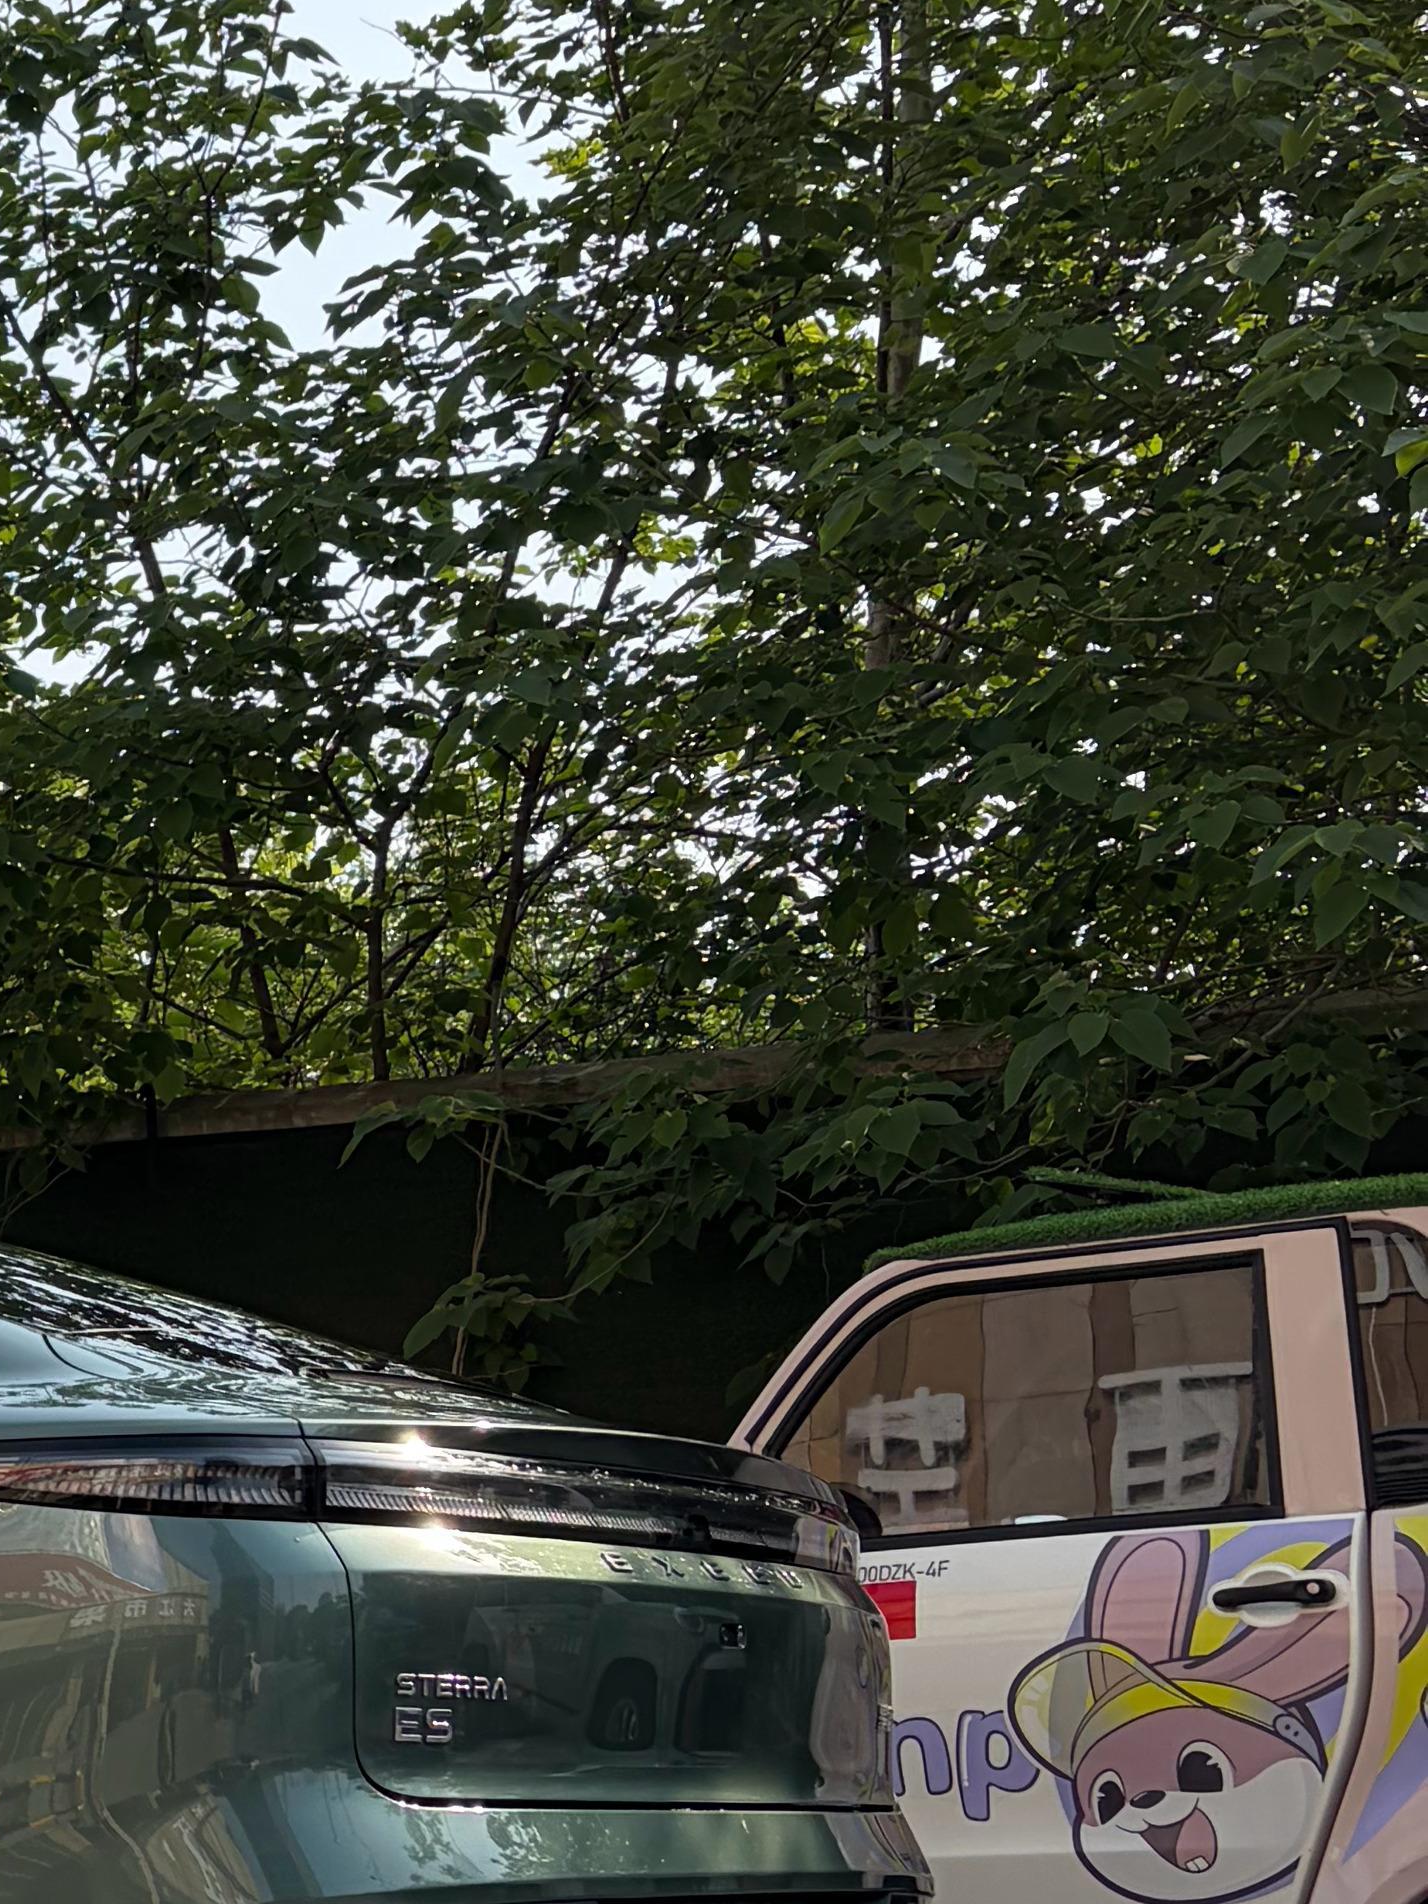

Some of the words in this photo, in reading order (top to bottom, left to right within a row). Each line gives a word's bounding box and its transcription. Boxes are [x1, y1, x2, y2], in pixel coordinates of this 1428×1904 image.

[857, 1559, 950, 1583] 00DZK-4F
[396, 1672, 508, 1701] STERRA
[394, 1706, 453, 1744] ES
